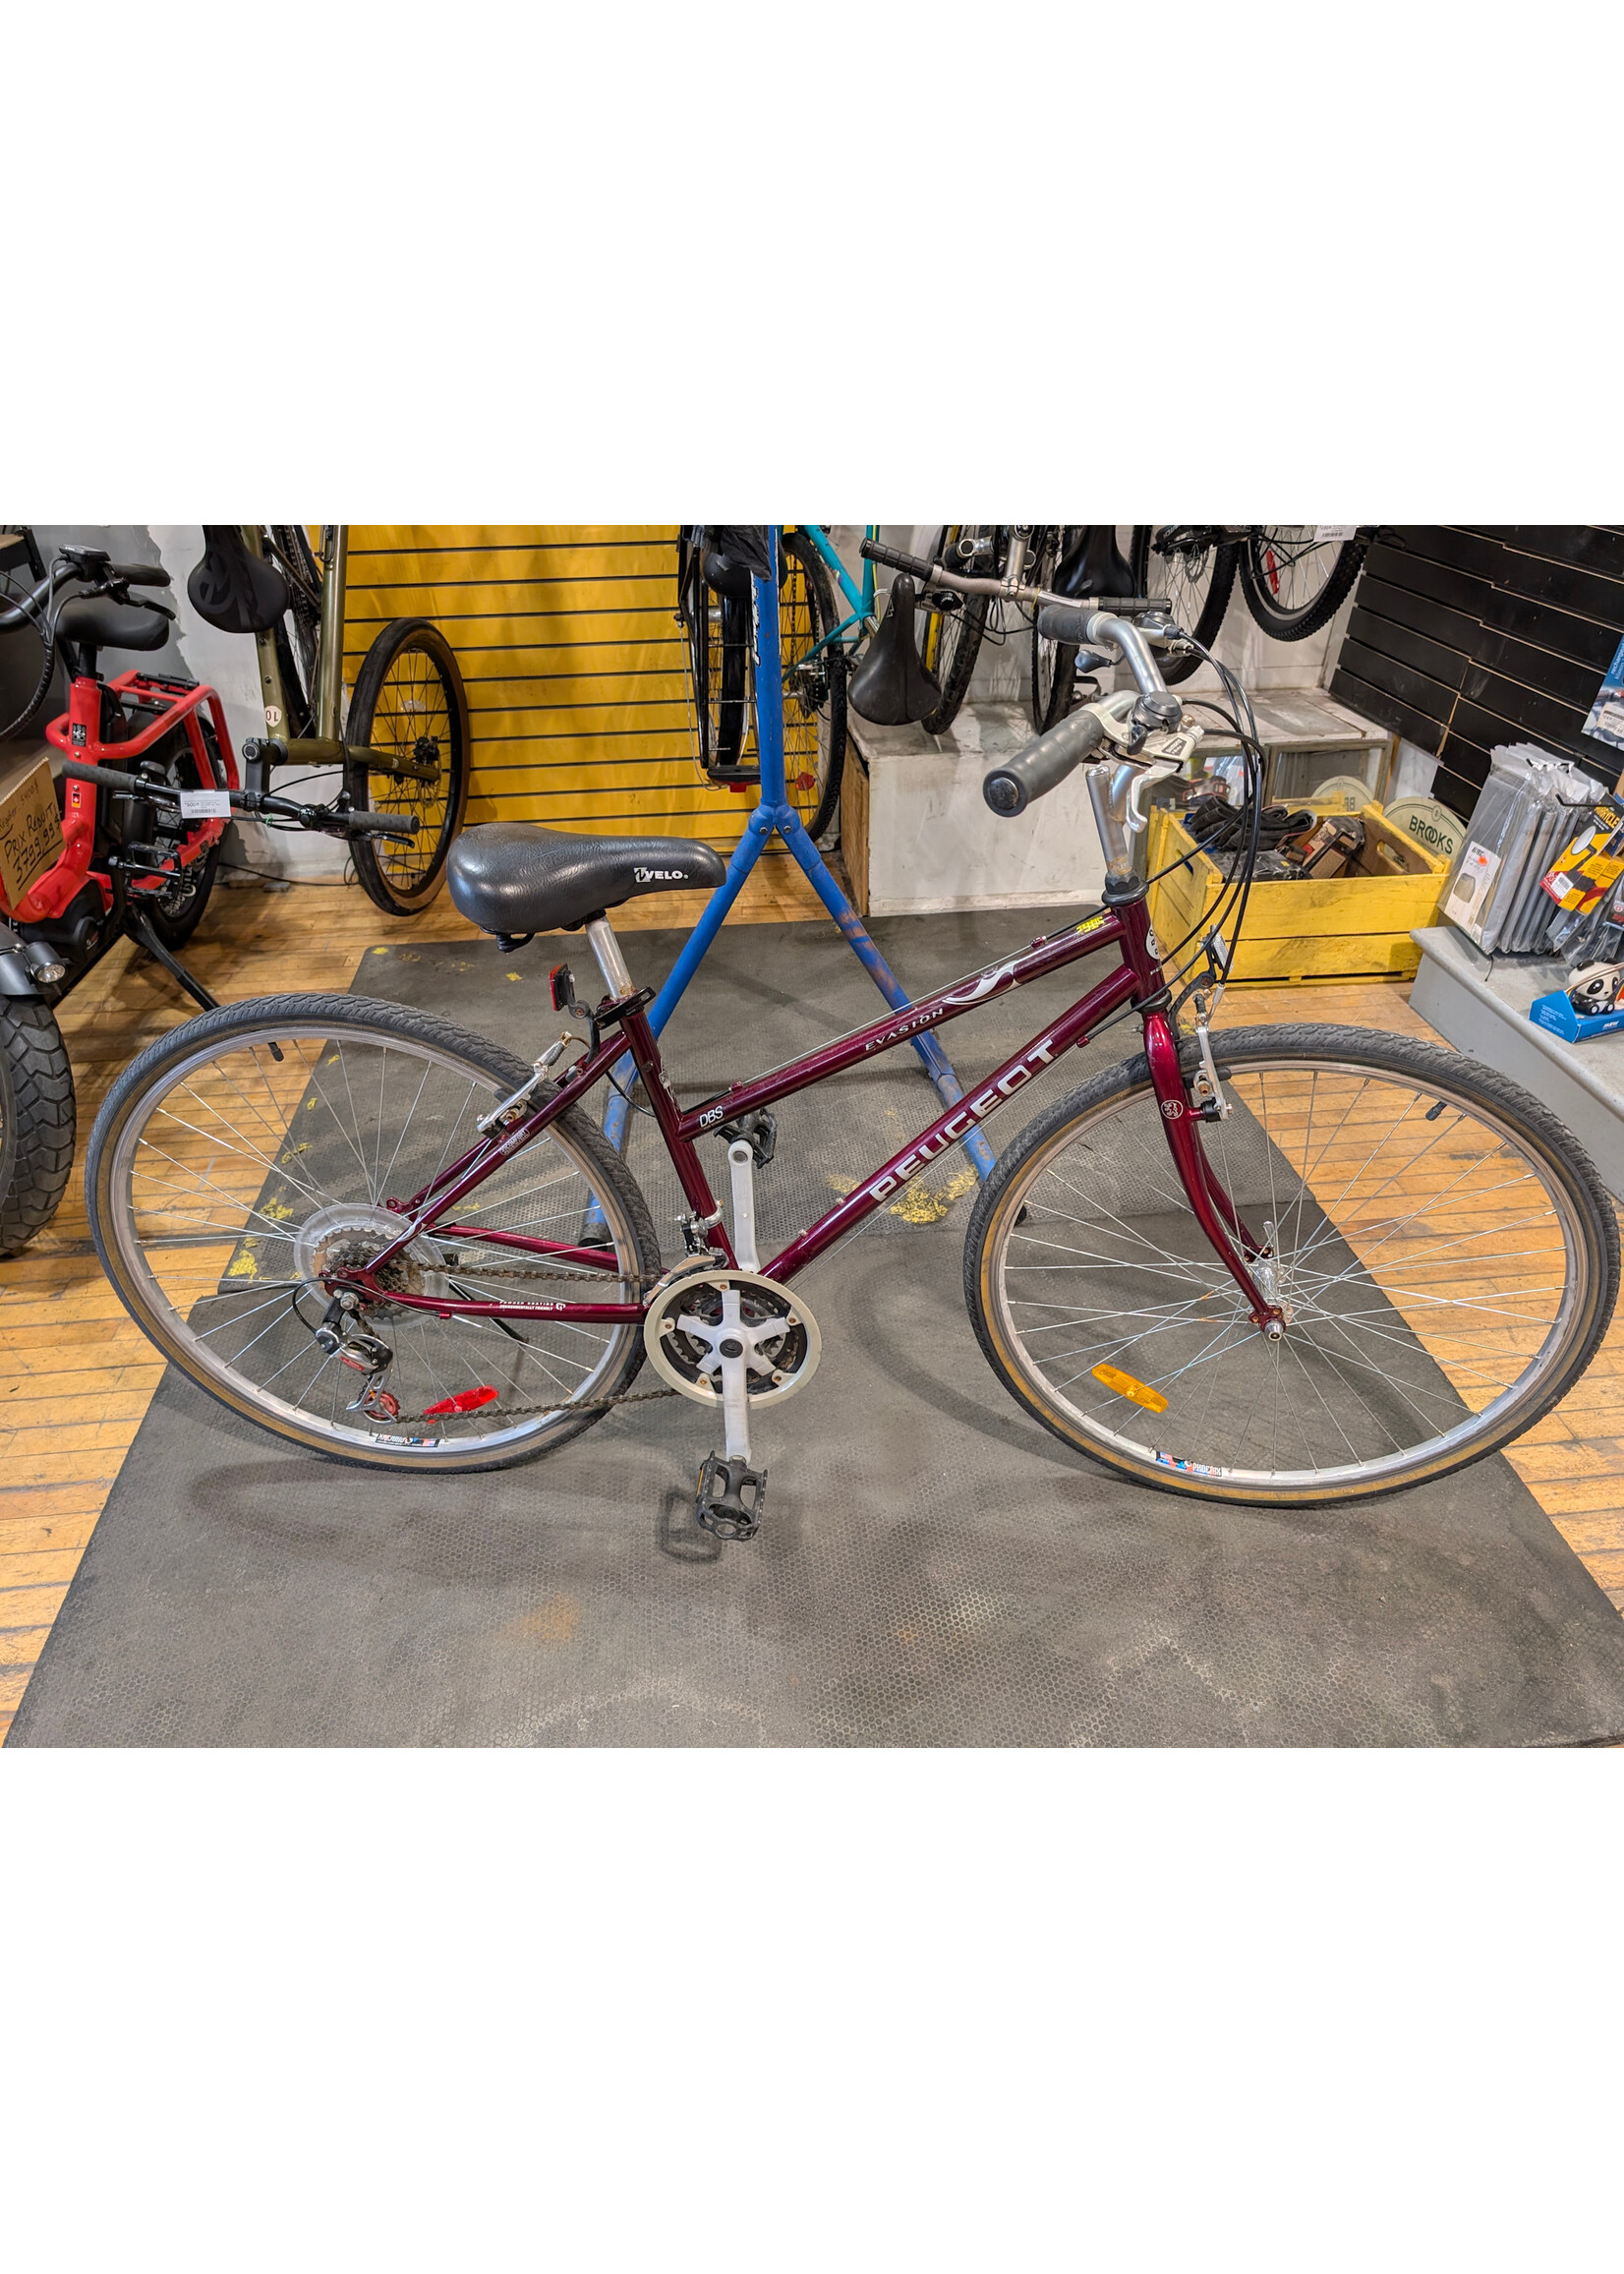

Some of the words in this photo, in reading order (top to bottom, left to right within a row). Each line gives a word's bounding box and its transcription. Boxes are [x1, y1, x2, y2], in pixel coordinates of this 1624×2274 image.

[4, 830, 27, 863] PRIX
[1409, 815, 1453, 854] BROOKS
[865, 1008, 944, 1051] EVASION
[699, 1105, 724, 1128] DBS
[869, 1039, 1055, 1202] PEUGEOT
[1192, 1462, 1222, 1477] PHOENIX
